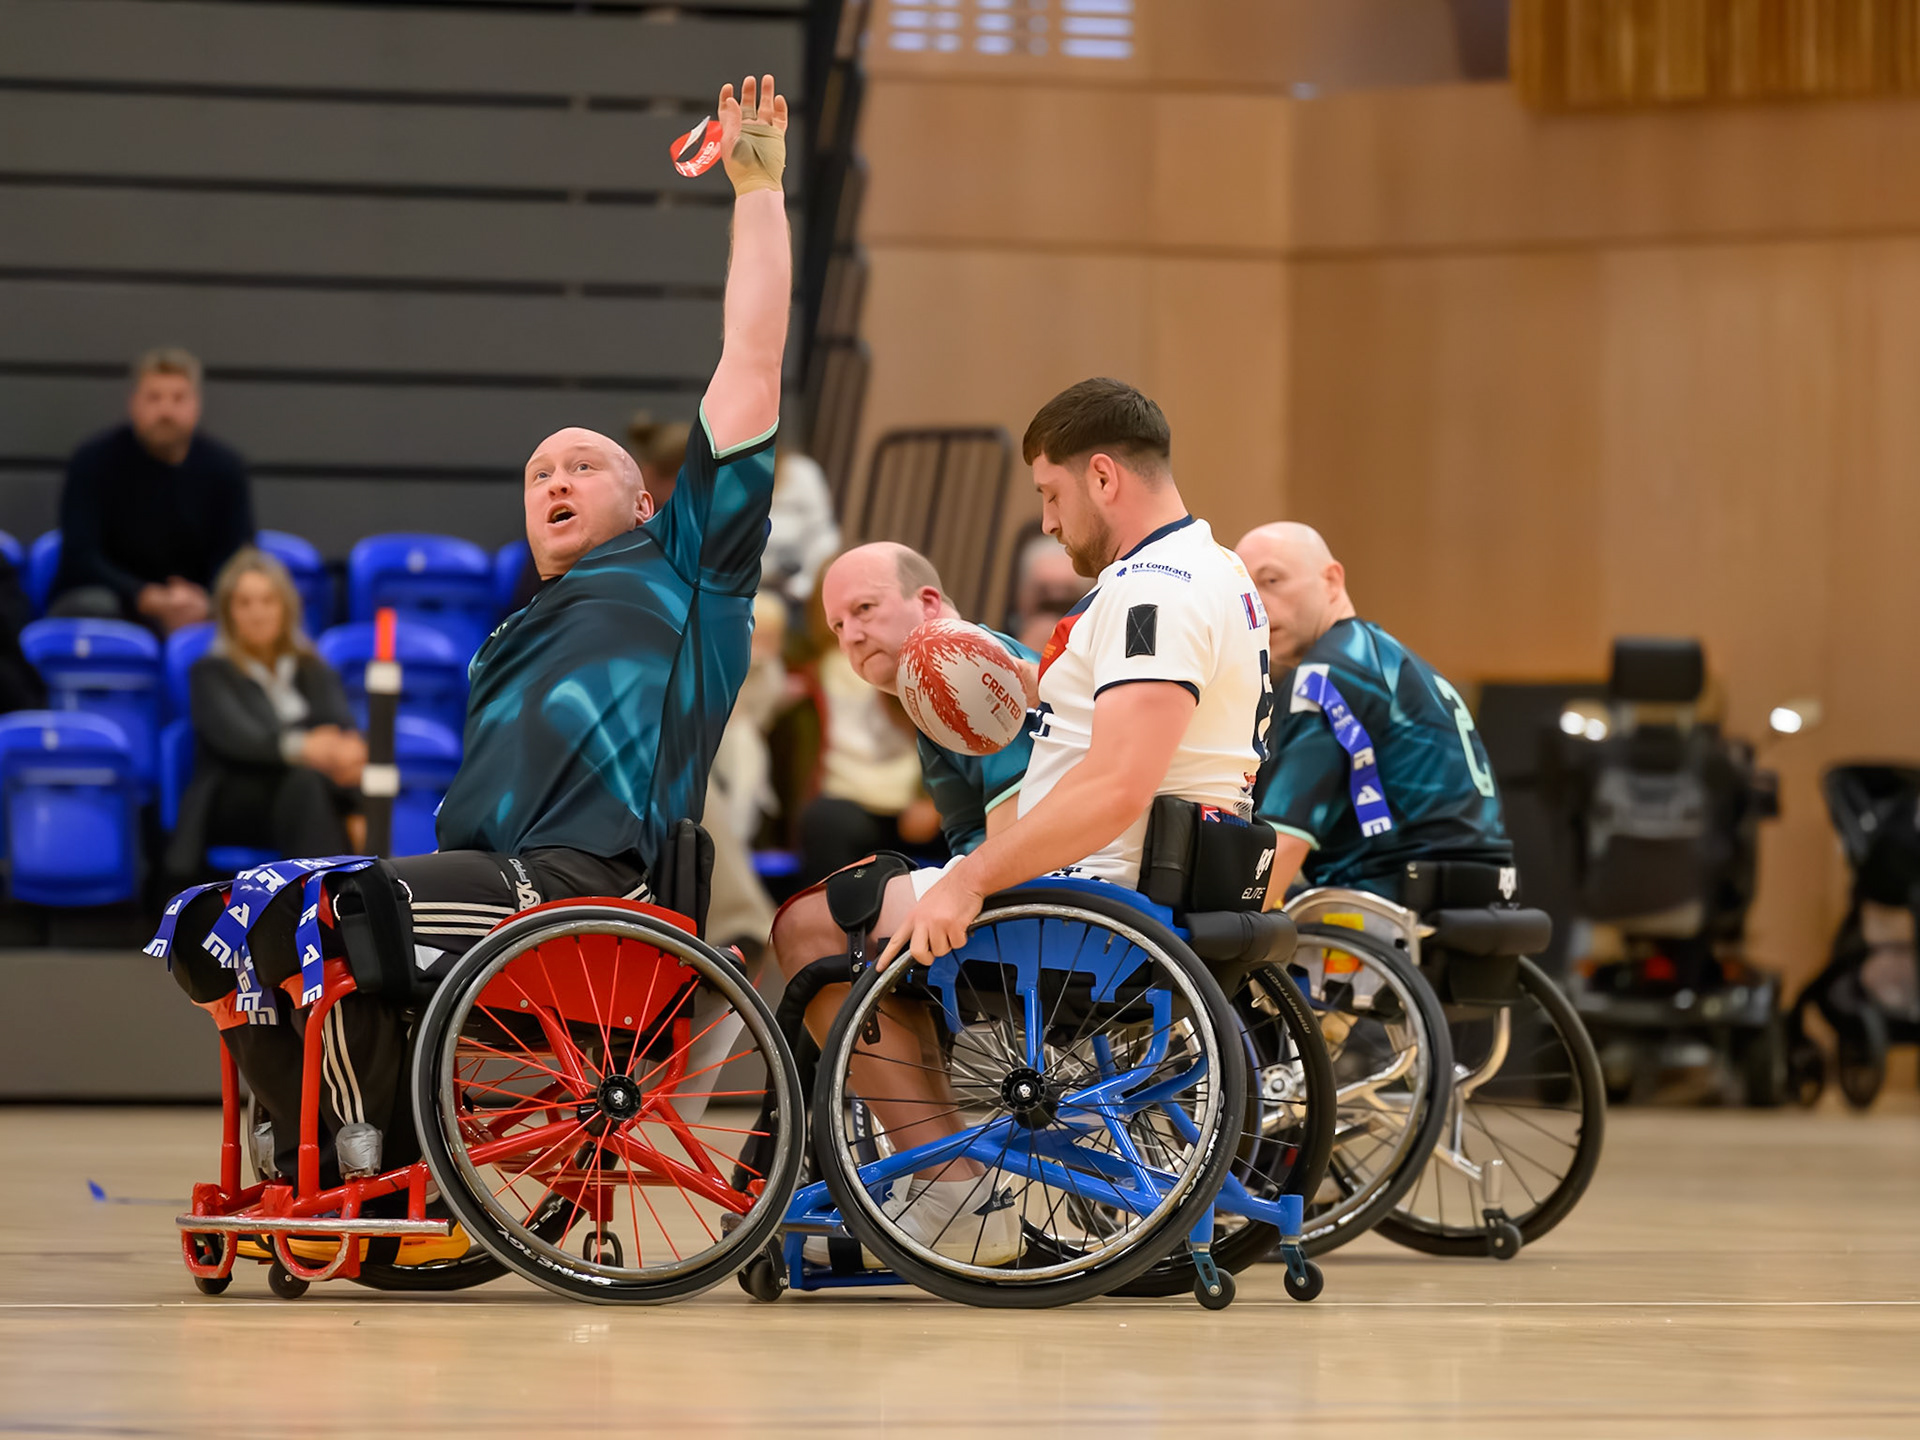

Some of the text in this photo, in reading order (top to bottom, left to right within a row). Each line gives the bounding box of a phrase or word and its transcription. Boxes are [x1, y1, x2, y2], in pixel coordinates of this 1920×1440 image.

[1146, 562, 1192, 579] Contracts
[981, 672, 1022, 721] CREATED
[1241, 887, 1266, 900] ELITE
[855, 1097, 866, 1138] KEN
[496, 1228, 612, 1286] SPINERGY
